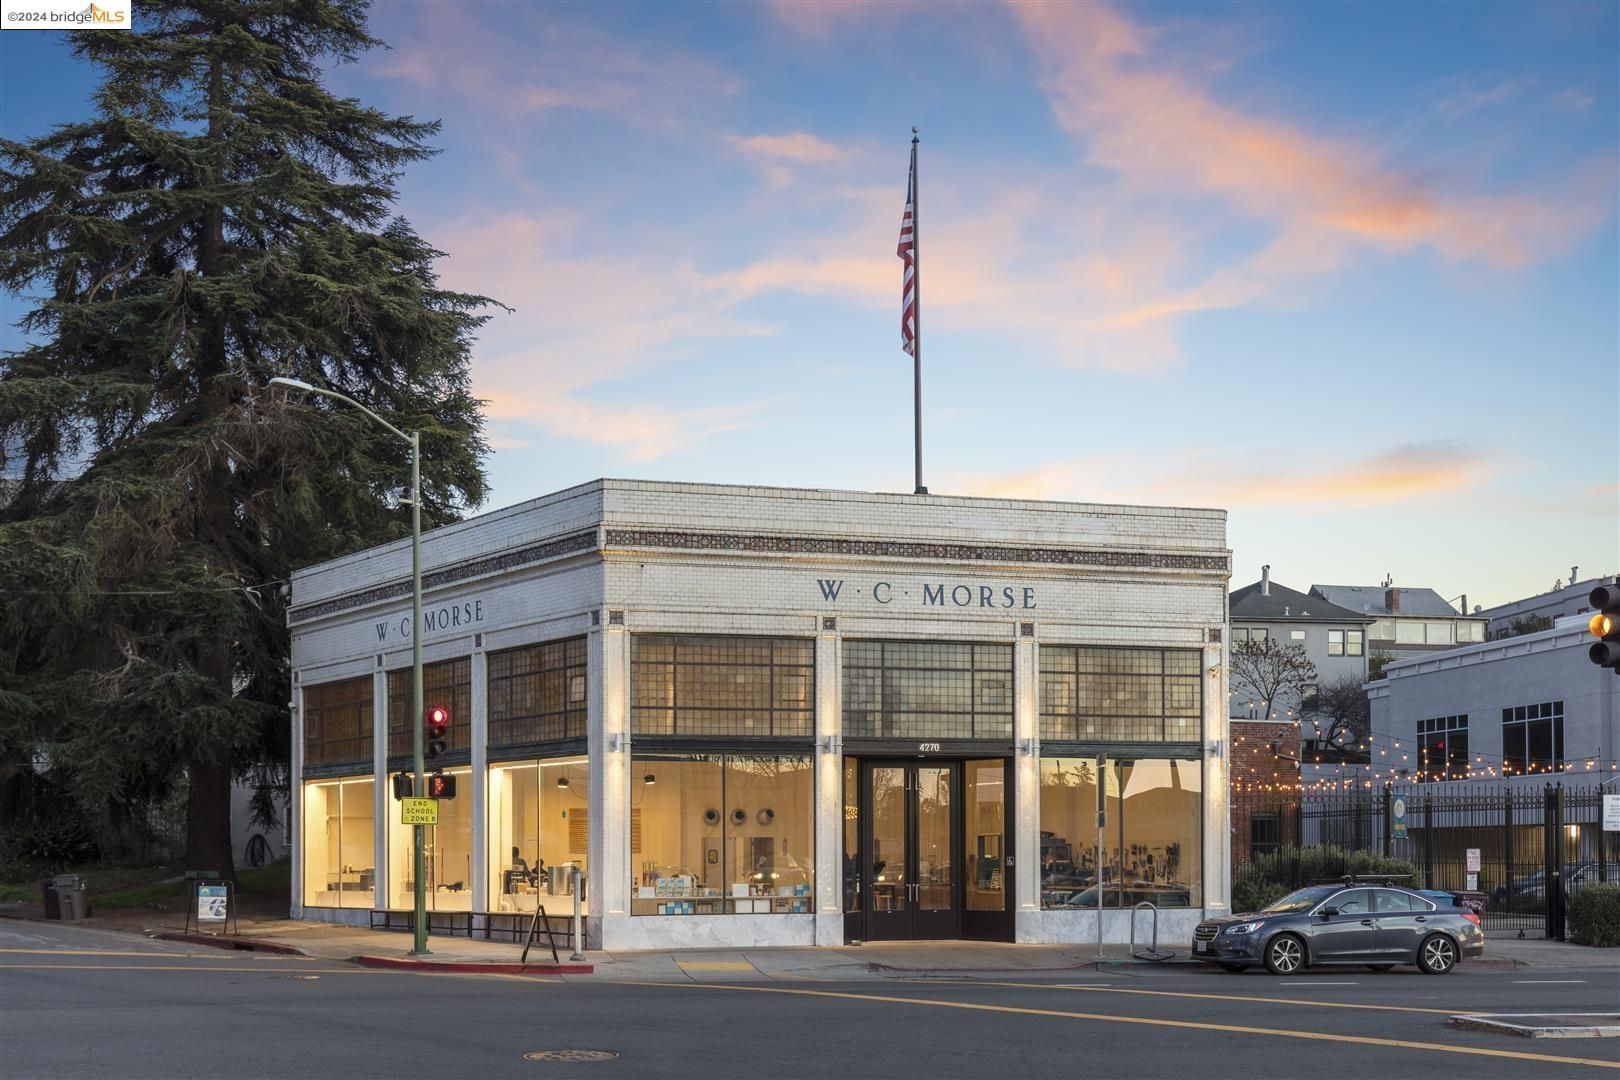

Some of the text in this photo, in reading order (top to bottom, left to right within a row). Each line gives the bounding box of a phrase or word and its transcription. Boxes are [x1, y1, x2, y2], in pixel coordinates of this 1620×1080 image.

[922, 583, 1037, 609] MORSE
[424, 600, 484, 633] MORSE
[919, 743, 940, 752] 4270
